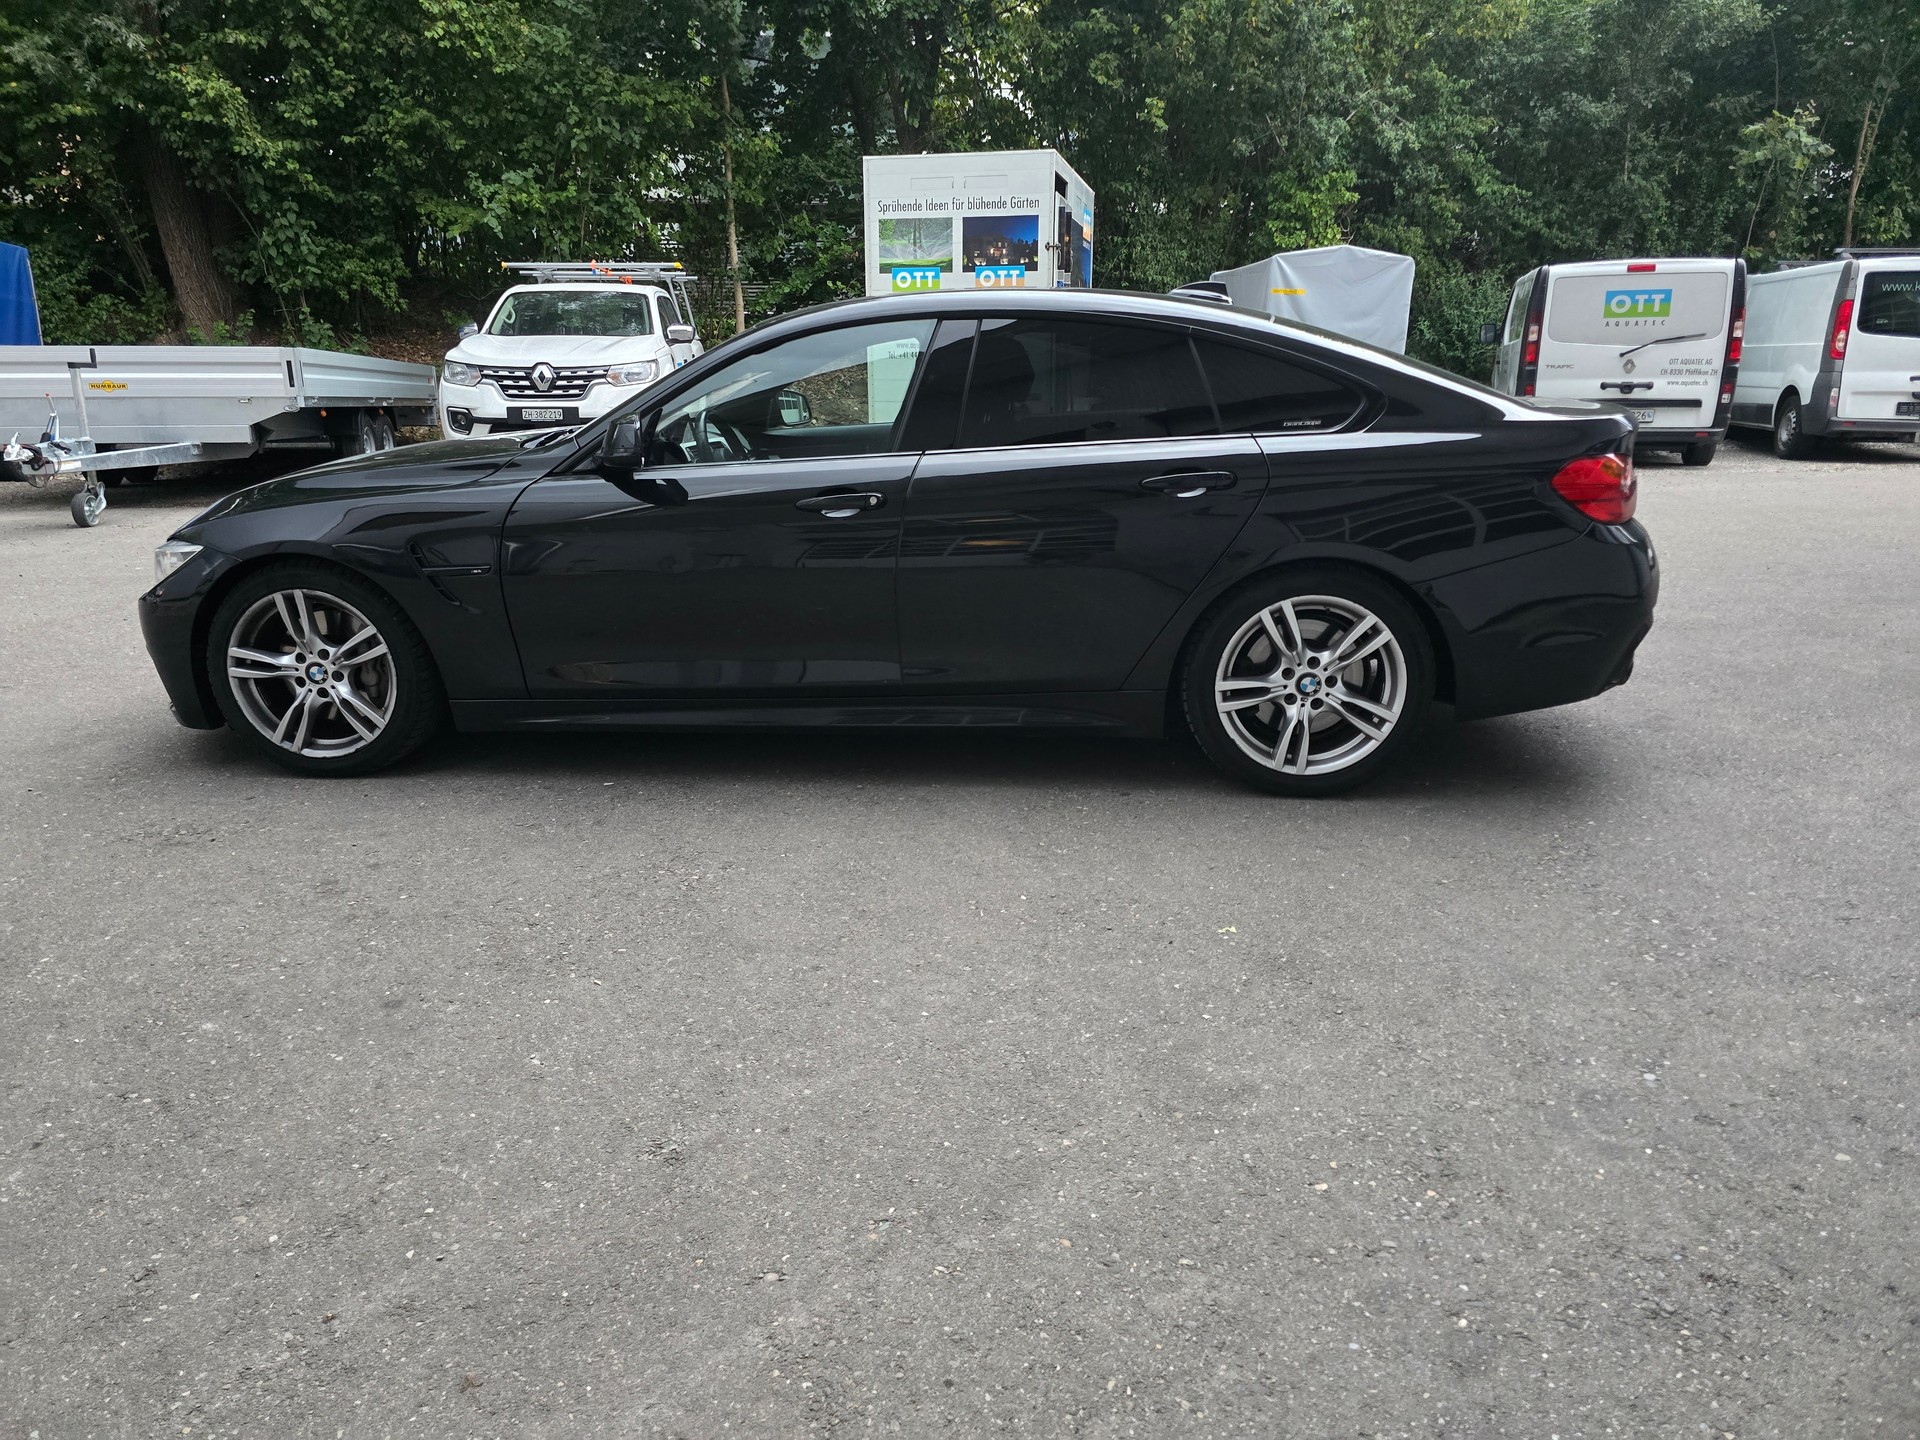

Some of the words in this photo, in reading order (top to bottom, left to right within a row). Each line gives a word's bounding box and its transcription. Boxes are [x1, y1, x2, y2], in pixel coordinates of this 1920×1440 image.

[877, 198, 923, 215] Sprühende
[925, 197, 949, 211] Ideen
[952, 196, 965, 210] für
[967, 195, 1007, 210] blühende
[1010, 195, 1040, 209] Gärten
[896, 271, 936, 288] OTT
[979, 270, 1020, 287] OTT
[1610, 294, 1666, 314] OTT
[1604, 320, 1665, 328] AQUATEC
[1669, 358, 1680, 366] OTT
[1680, 358, 1704, 366] AQUATEC
[1704, 358, 1713, 366] AG
[1660, 368, 1684, 376] CH-8330
